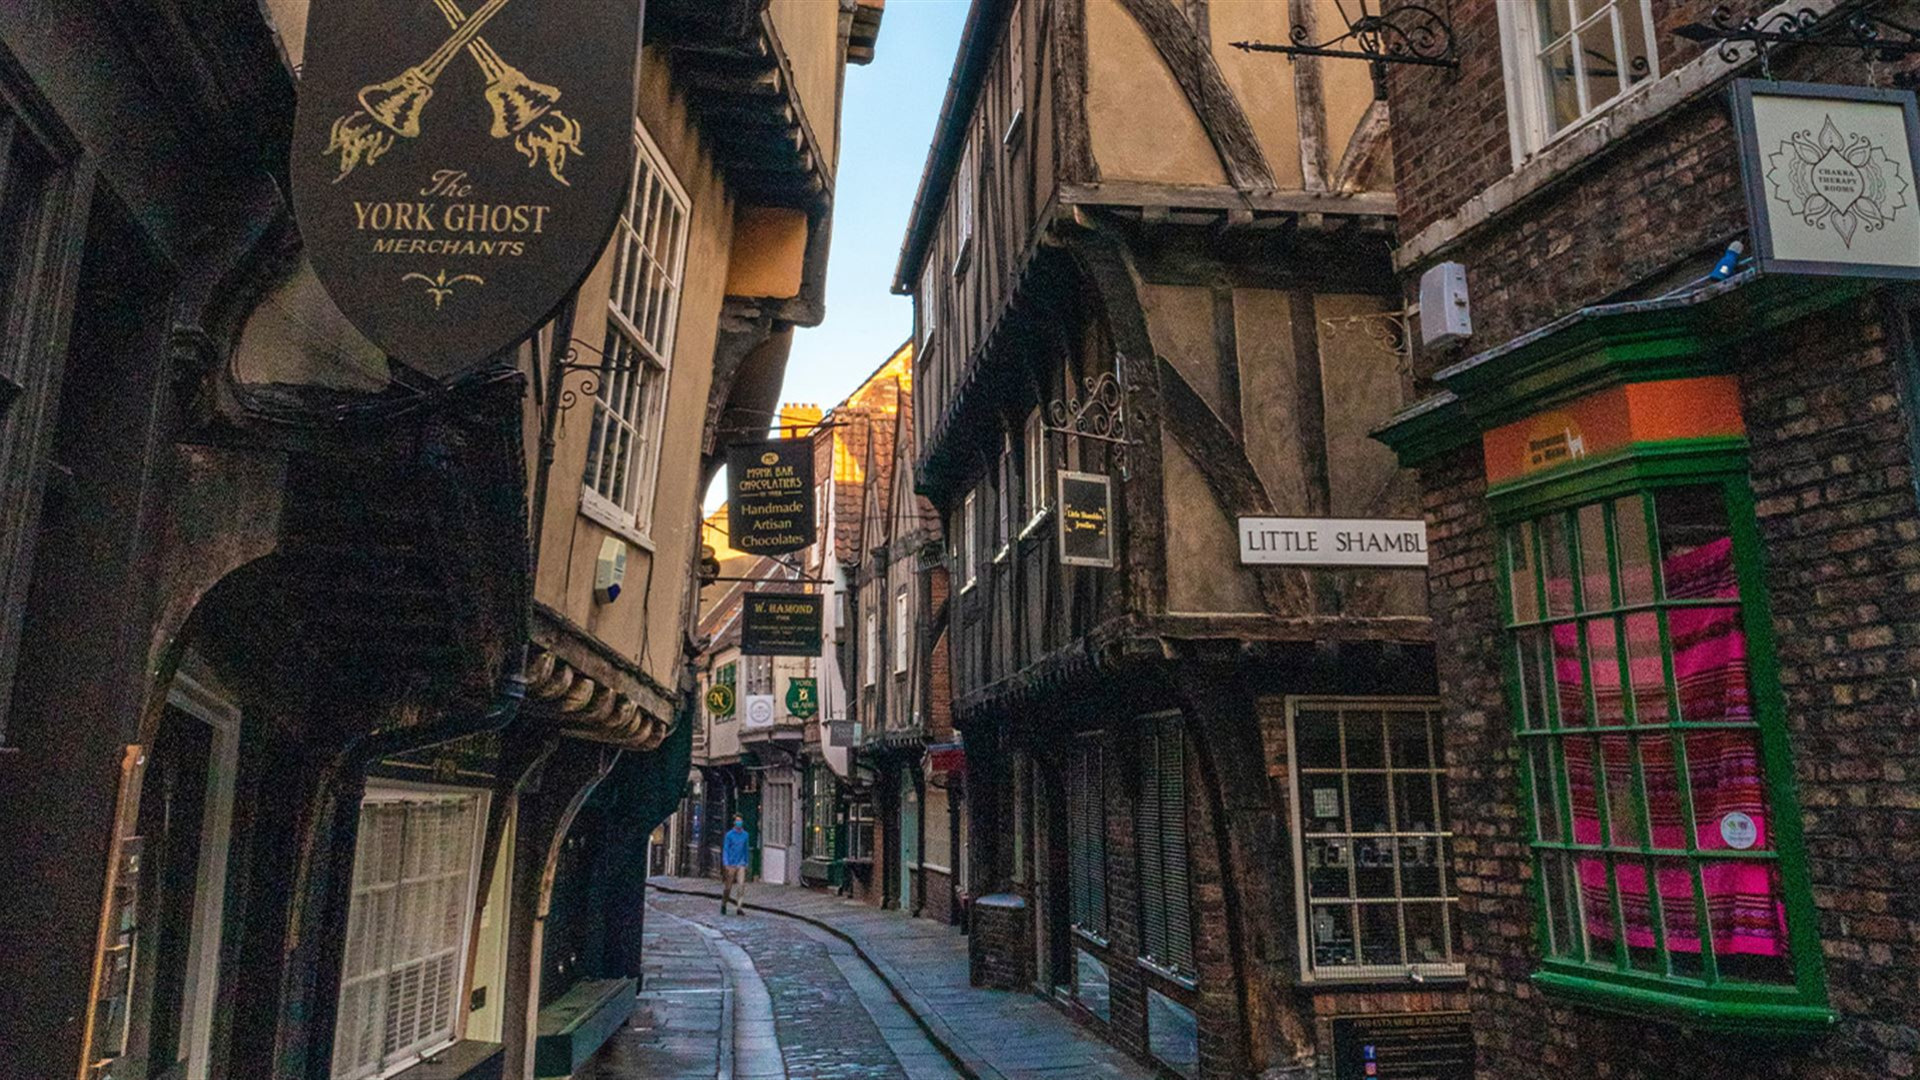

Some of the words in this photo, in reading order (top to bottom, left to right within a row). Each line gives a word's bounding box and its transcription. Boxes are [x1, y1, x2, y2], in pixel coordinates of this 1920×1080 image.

[420, 169, 472, 198] The
[353, 202, 436, 232] YORK
[443, 204, 551, 233] GHOST
[373, 238, 525, 256] MERCHANTS
[775, 466, 794, 477] BAR
[741, 501, 804, 515] Handmade
[752, 517, 792, 531] Artisan
[741, 532, 805, 548] Chocolates
[1248, 530, 1320, 552] LITTLE
[754, 601, 767, 614] W.
[768, 603, 814, 614] HAMOND
